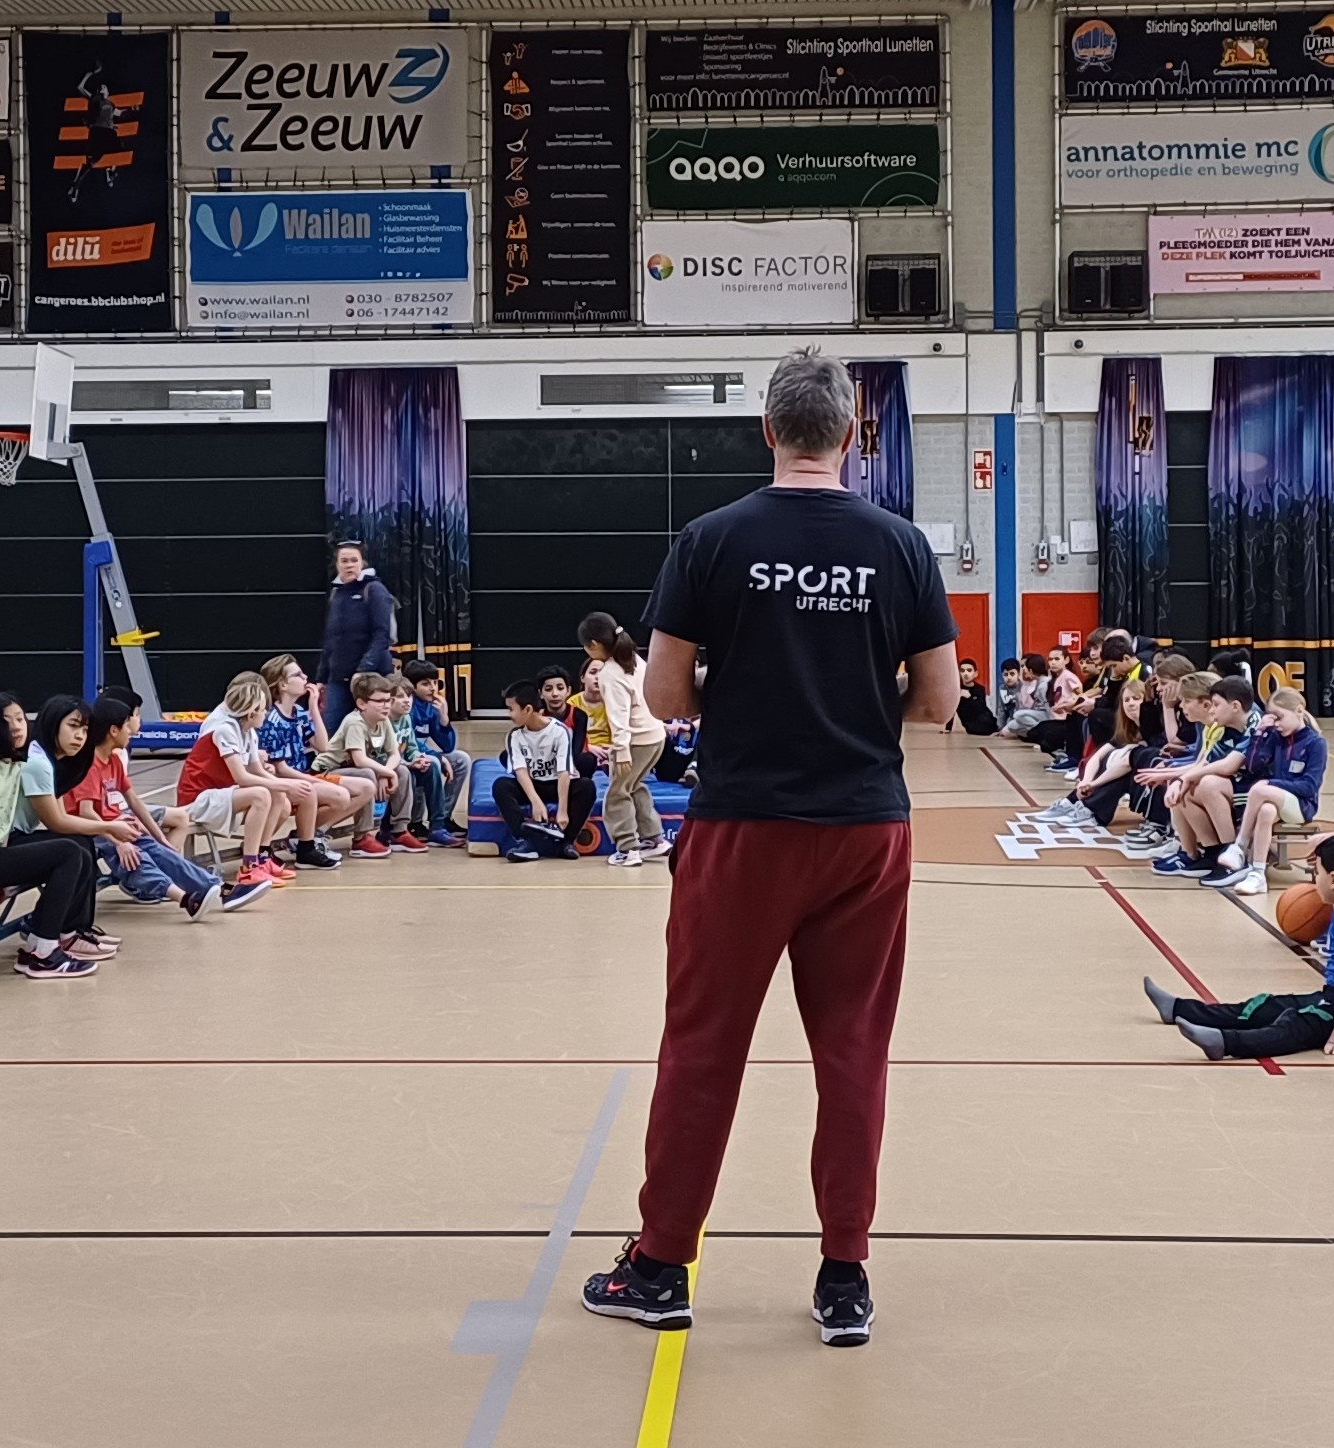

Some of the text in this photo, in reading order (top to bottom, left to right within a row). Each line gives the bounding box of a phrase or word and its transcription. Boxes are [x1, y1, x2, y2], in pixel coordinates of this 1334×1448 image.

[1146, 17, 1278, 36] Stichting Sporthal Lunetten
[786, 36, 934, 58] Stichting Sporthal Lunetten
[204, 50, 389, 101] Zeeuw
[205, 102, 424, 153] & Zeeuw
[1066, 137, 1299, 163] annatommie mc
[776, 152, 917, 169] Verhuursoftware
[1067, 161, 1299, 180] voor orthopedie en beweging
[1241, 228, 1283, 238] ZOEKT
[1285, 227, 1311, 237] EEN
[1159, 240, 1249, 250] PLEEGMOEDER
[1251, 239, 1272, 248] DIE
[1274, 238, 1301, 248] HEM
[1161, 251, 1193, 261] DEZE
[1195, 251, 1227, 260] PLEK
[1229, 250, 1263, 260] KOMT
[682, 255, 848, 277] DISC FACTOR
[721, 280, 848, 293] inspirerend motiverend
[34, 291, 165, 308] cangeroes.bbclubshop.nl
[357, 294, 382, 304] 030
[394, 292, 454, 303] 8782507
[749, 563, 876, 595] SPORT
[796, 596, 871, 613] UTRECHT
